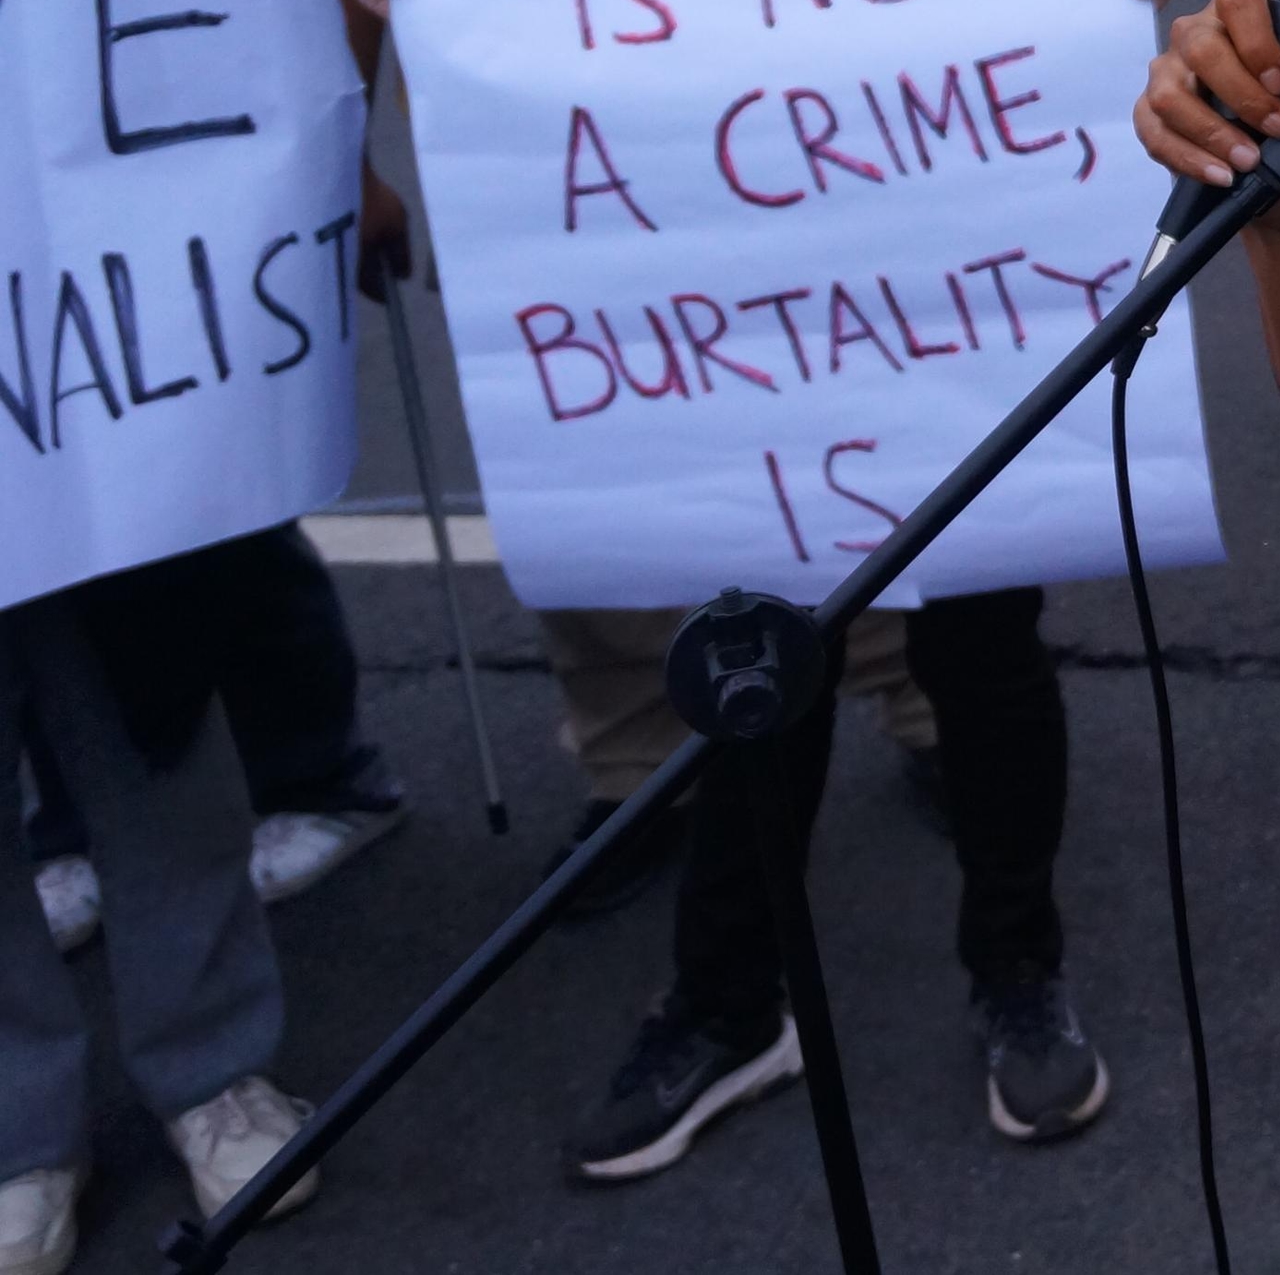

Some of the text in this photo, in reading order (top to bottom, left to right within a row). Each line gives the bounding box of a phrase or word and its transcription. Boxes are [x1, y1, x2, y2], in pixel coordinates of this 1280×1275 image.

[562, 45, 1098, 233] A CRIME,
[515, 248, 1132, 423] BURTALITY
[763, 437, 908, 565] IS
